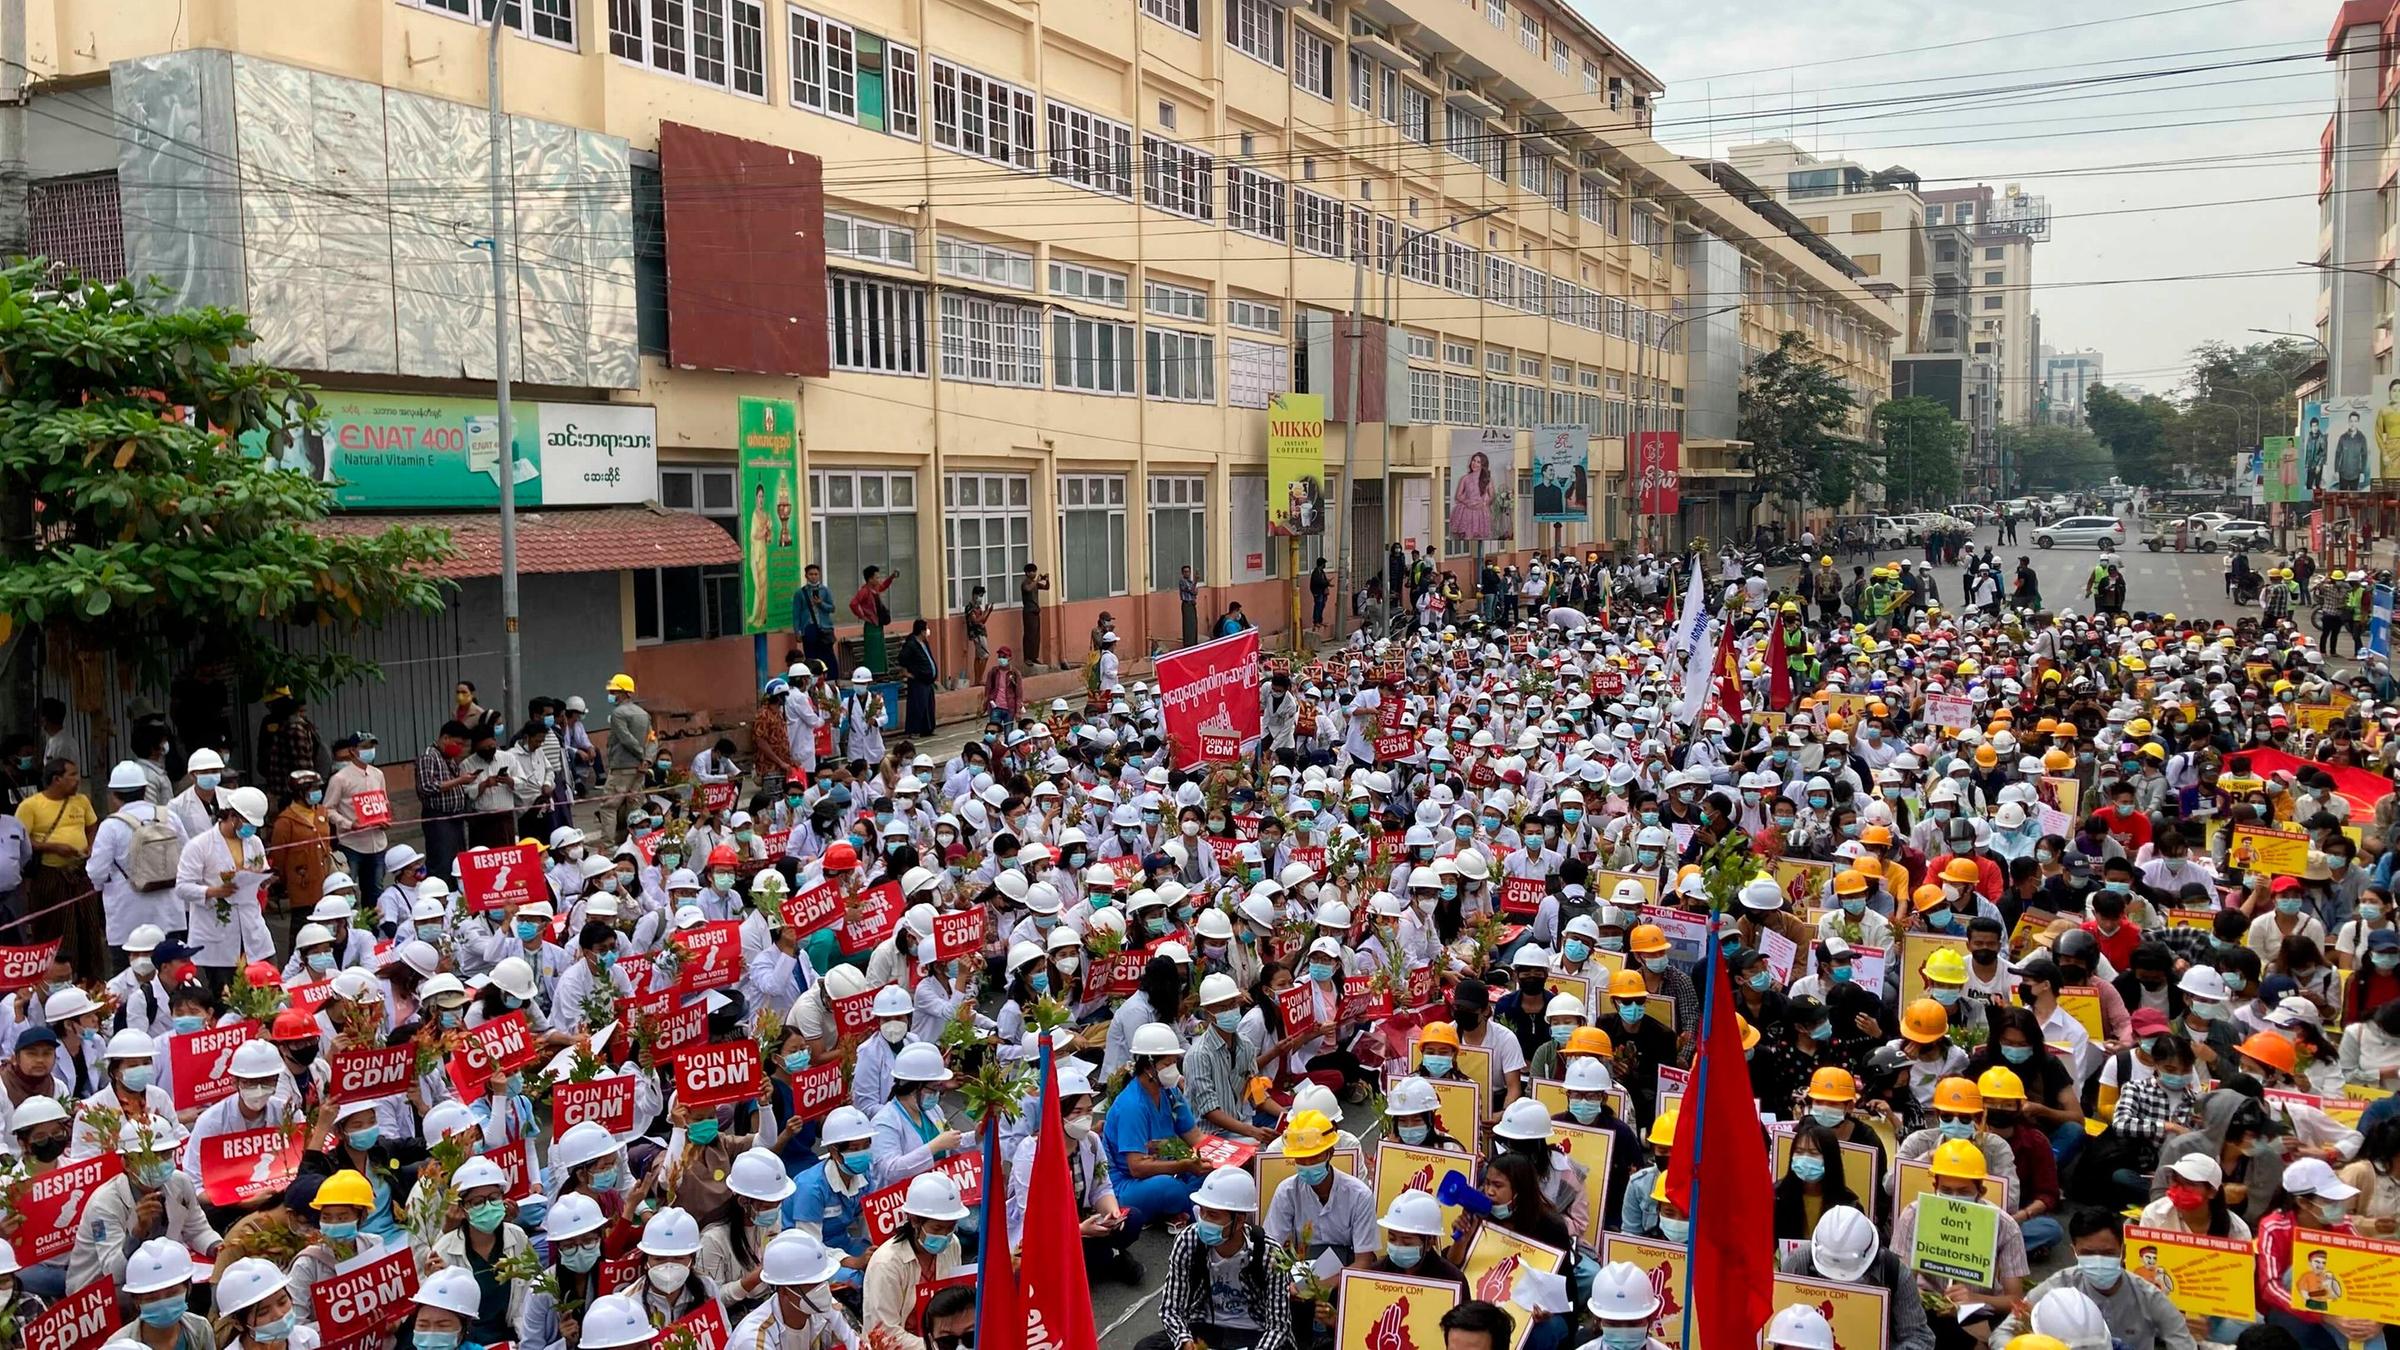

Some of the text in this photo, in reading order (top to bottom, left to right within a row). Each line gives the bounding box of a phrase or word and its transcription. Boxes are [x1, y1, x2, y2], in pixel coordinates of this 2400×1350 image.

[1272, 421, 1322, 438] MIKKO
[422, 427, 464, 452] 400
[345, 453, 435, 467] Natural Vitamin E
[1226, 737, 1234, 746] IN
[1399, 736, 1407, 744] IN
[703, 787, 719, 796] OIN
[473, 849, 523, 870] RESPECT
[482, 892, 499, 901] OUR
[501, 888, 528, 898] VOTES
[819, 886, 832, 898] IN
[1535, 883, 1546, 892] IN
[970, 913, 980, 924] IN
[687, 928, 728, 949] RESPECT
[1119, 955, 1141, 966] OIN
[692, 972, 708, 982] OUR
[708, 967, 729, 978] VOTES
[302, 983, 334, 1004] RESPE
[690, 1007, 701, 1020] IN
[502, 1018, 518, 1036] IN
[191, 1027, 248, 1055] RESPECT
[336, 1049, 407, 1073] “JOIN IN
[677, 1047, 749, 1072] “JOIN IN
[194, 1080, 215, 1092] OUR
[795, 1072, 828, 1091] “JOIN
[557, 1083, 625, 1106] “JOIN IN
[1404, 1151, 1446, 1165] Support CDM
[33, 1161, 104, 1203] RESPECT
[235, 1180, 261, 1194] OUR
[1949, 1200, 1967, 1214] We
[877, 1206, 907, 1235] CD
[1940, 1216, 1972, 1232] don't
[35, 1229, 62, 1247] OUR
[1502, 1236, 1536, 1256] Support CDM
[1940, 1232, 1970, 1247] want
[1637, 1246, 1686, 1261] Support CDM
[1916, 1240, 1991, 1268] Dictatorship
[1945, 1265, 1980, 1280] MYANMAR
[316, 1260, 401, 1305] “JOIN IN
[1374, 1281, 1424, 1297] Support CDM
[1795, 1285, 1849, 1301] Support CDM
[29, 1286, 105, 1345] “JOIN IN
